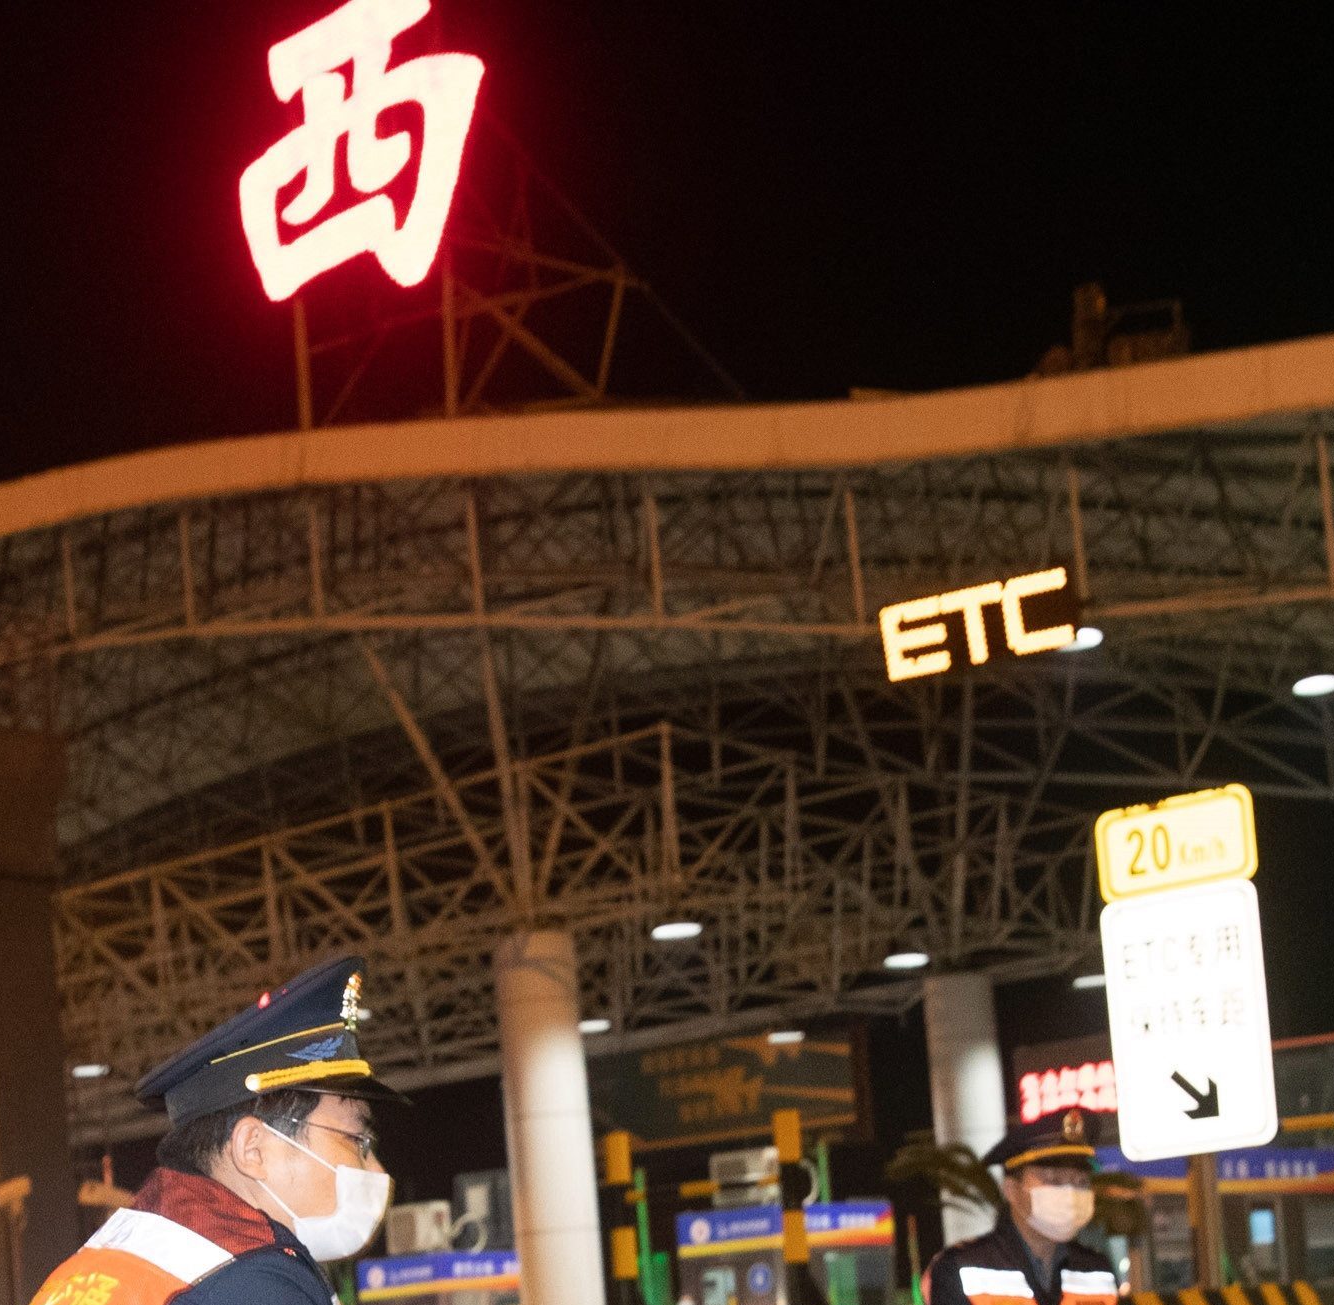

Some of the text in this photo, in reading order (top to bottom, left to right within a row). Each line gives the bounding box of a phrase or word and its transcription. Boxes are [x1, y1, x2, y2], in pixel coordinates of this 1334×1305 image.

[239, 0, 485, 302] 西
[879, 566, 1075, 682] ETC
[1126, 824, 1171, 876] 20
